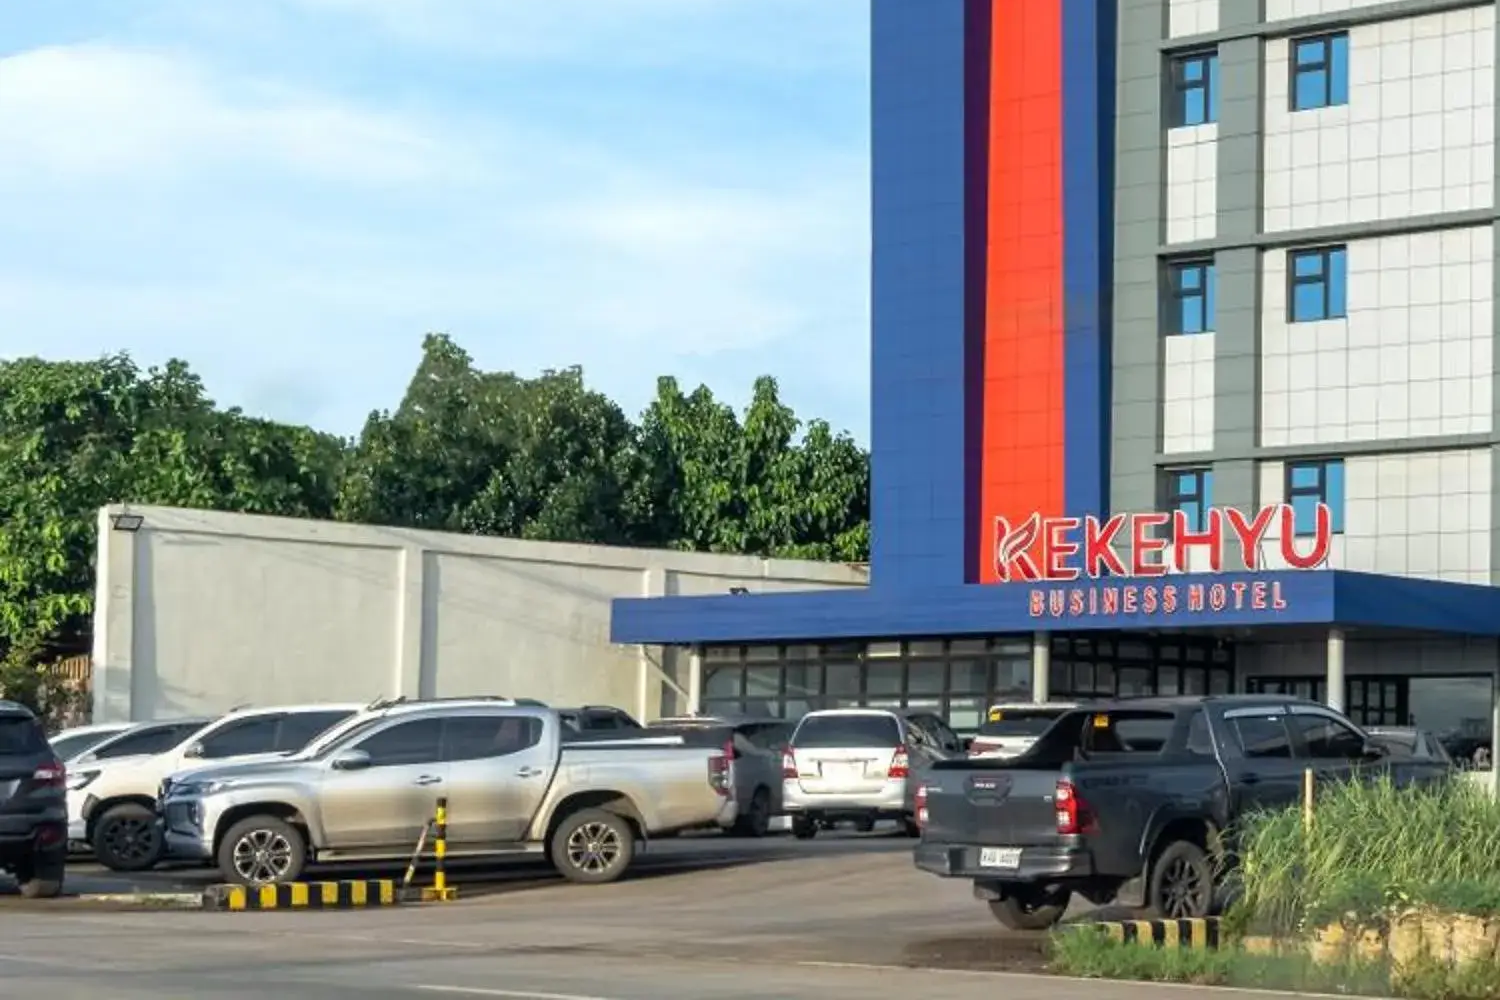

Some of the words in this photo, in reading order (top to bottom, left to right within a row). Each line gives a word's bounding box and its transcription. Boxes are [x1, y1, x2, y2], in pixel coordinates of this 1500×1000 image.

[994, 502, 1332, 582] KEKEHYU
[1029, 584, 1177, 617] BUSINESS
[1187, 581, 1287, 611] HOTEL
